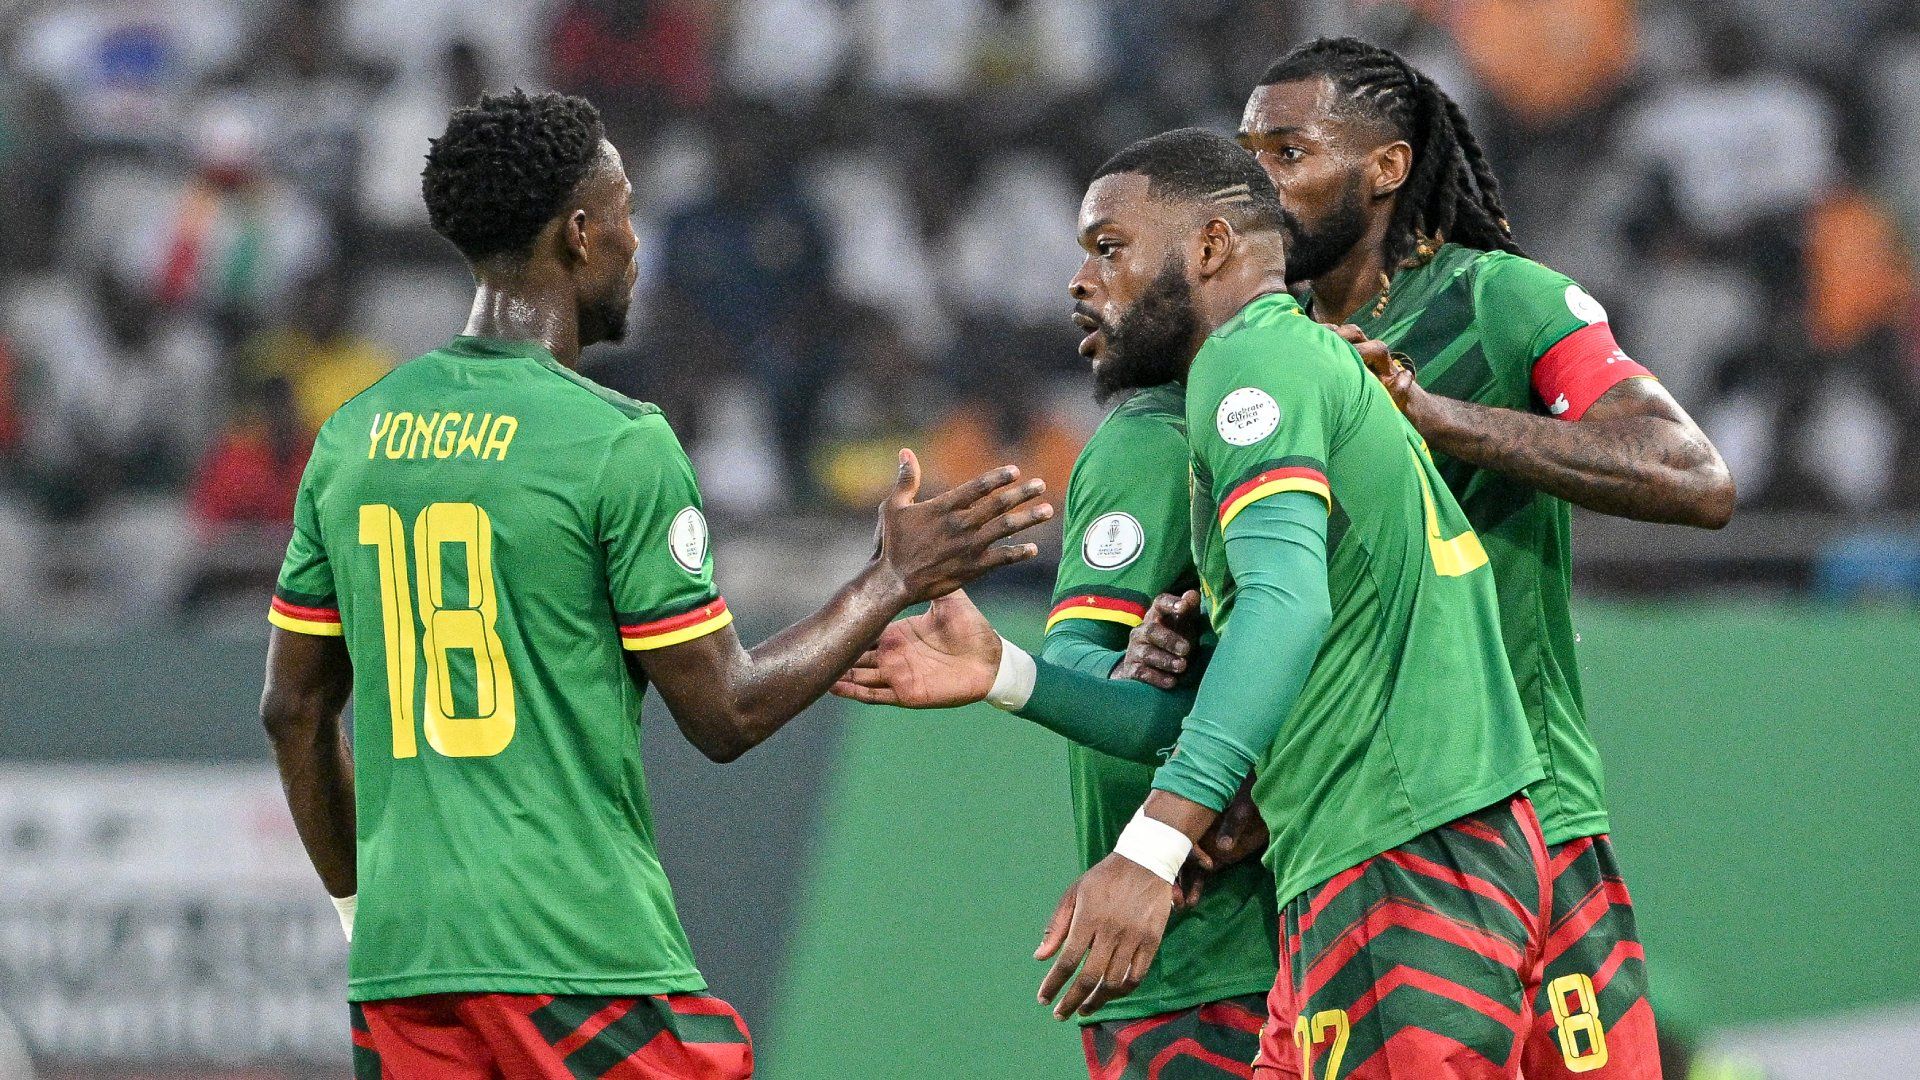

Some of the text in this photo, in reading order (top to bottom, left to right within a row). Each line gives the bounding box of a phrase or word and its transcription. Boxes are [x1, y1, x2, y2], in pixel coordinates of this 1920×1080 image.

[368, 412, 518, 461] YONGWA
[359, 502, 516, 759] 18
[1547, 973, 1609, 1072] 8
